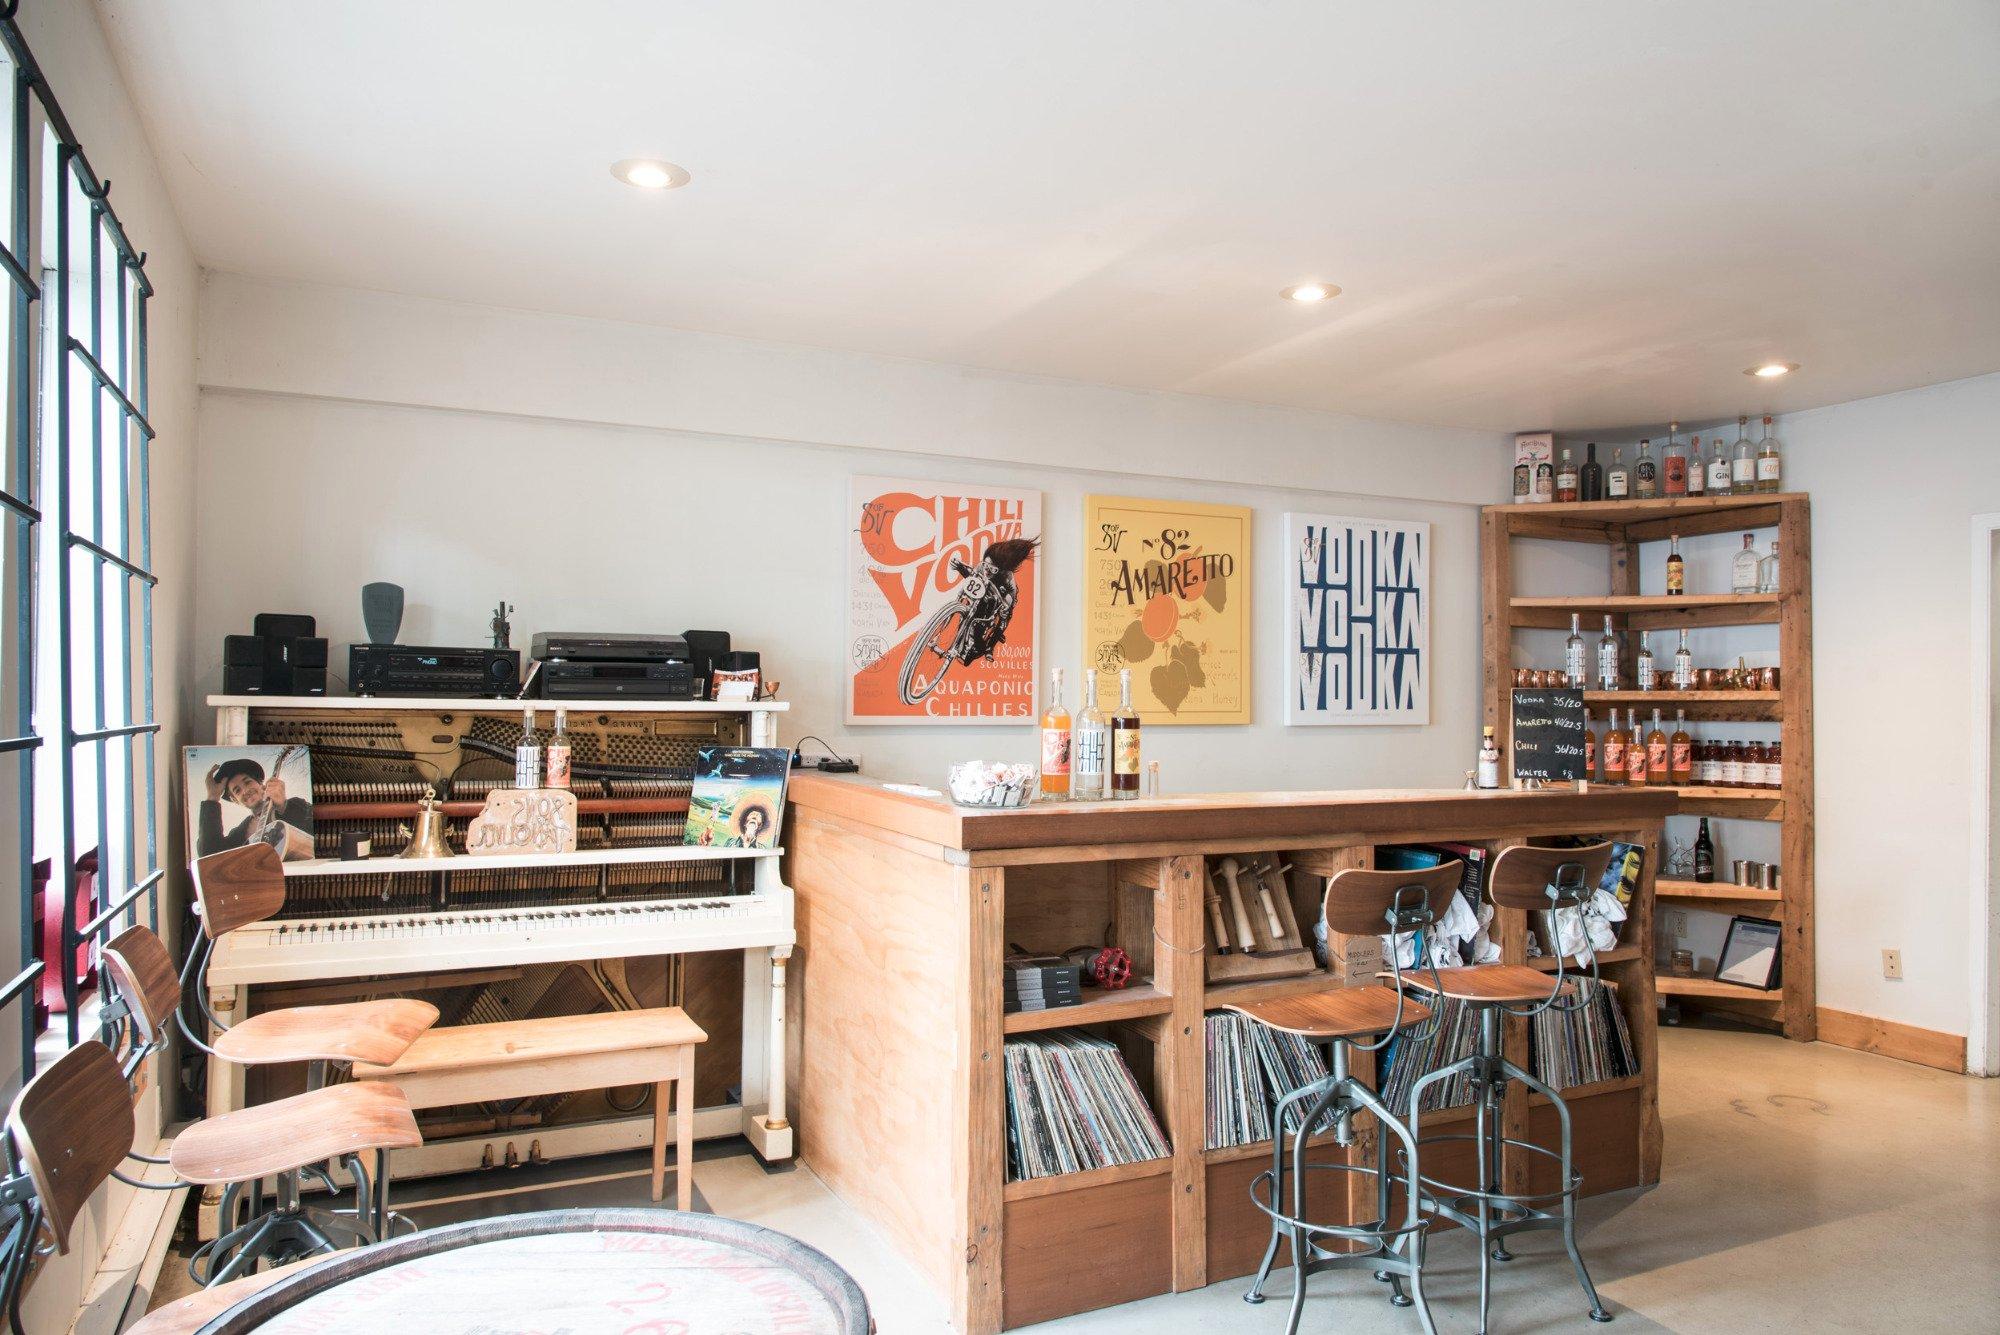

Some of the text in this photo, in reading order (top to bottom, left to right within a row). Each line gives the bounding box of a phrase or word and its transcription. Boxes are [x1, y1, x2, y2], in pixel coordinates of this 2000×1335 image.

[1716, 472, 1730, 480] GIN
[860, 492, 1024, 567] CHILI
[1110, 553, 1234, 606] AMARETTO
[966, 580, 981, 596] 82
[980, 660, 1034, 670] SCOVILLES
[926, 696, 1029, 718] CHILIES
[1514, 694, 1582, 708] VODKA 35/20
[1515, 718, 1552, 727] AMARETTO
[1515, 740, 1538, 751] CHILI
[1516, 768, 1549, 777] WALTER
